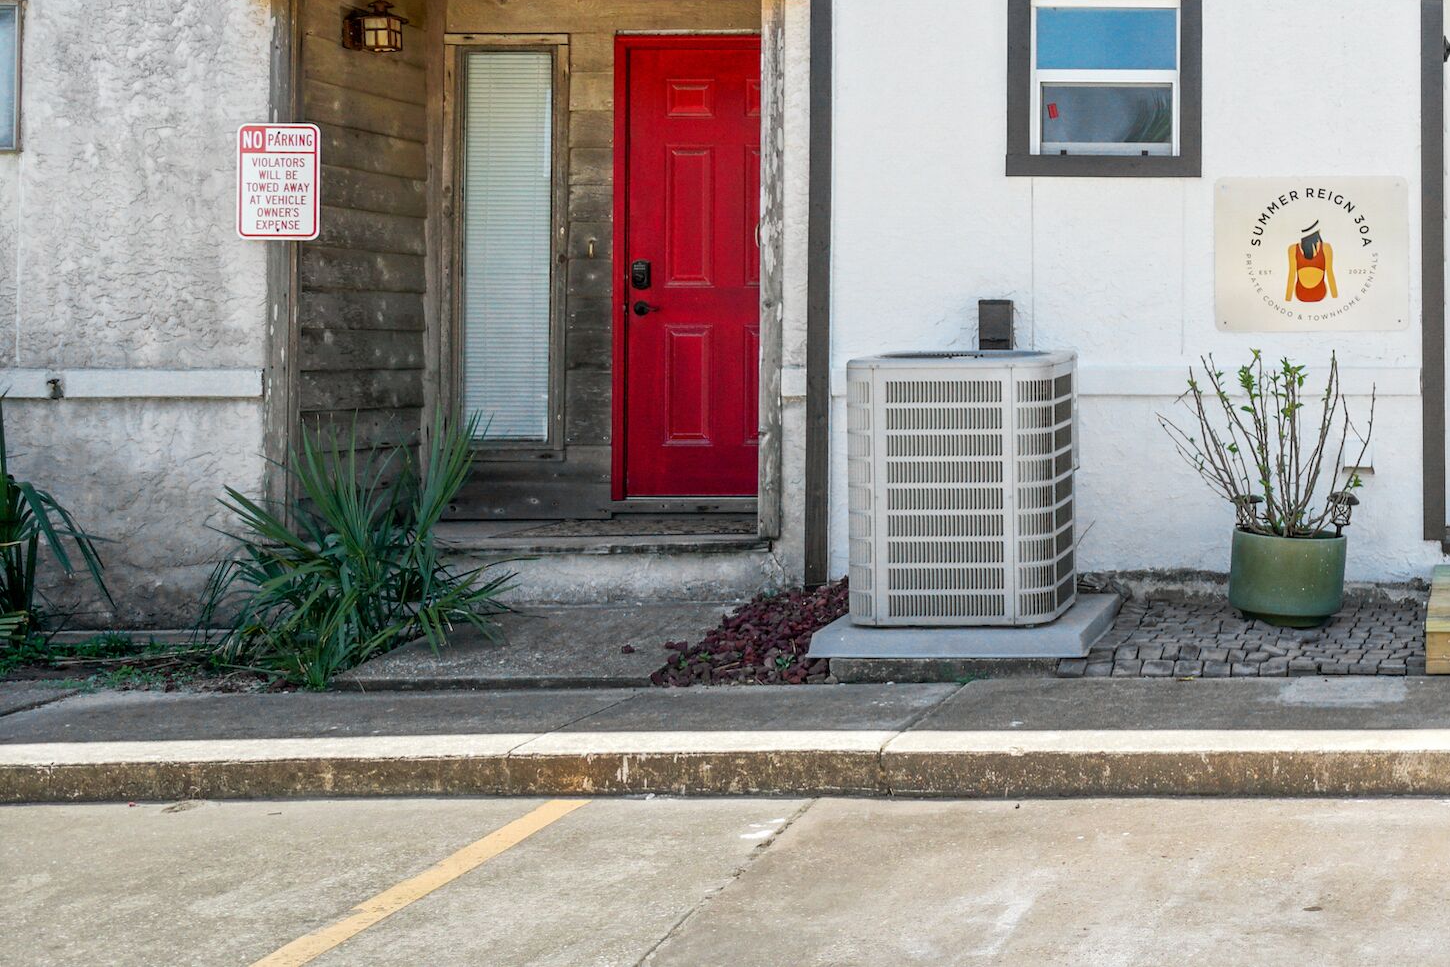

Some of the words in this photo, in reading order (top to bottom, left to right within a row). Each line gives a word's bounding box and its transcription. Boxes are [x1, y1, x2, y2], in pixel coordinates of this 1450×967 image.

[243, 130, 263, 149] NO
[267, 133, 313, 147] PARKING
[252, 157, 305, 168] VIOLATORS
[258, 170, 281, 180] WILL
[285, 170, 298, 180] BE
[246, 182, 279, 193] TOWED
[283, 182, 310, 193] AWAY
[250, 195, 261, 205] AT
[266, 195, 307, 205] VEHICLE
[257, 207, 300, 217] OWNER'S
[1250, 190, 1300, 247] SUMMER
[1306, 187, 1356, 214] REIGN
[1354, 214, 1373, 247] 30A
[256, 220, 300, 230] EXPENSE
[1245, 253, 1263, 294] PRIVATE
[1263, 295, 1293, 318] CONDO
[1307, 296, 1361, 322] TOWNHOME
[1360, 252, 1379, 294] RENTALS
